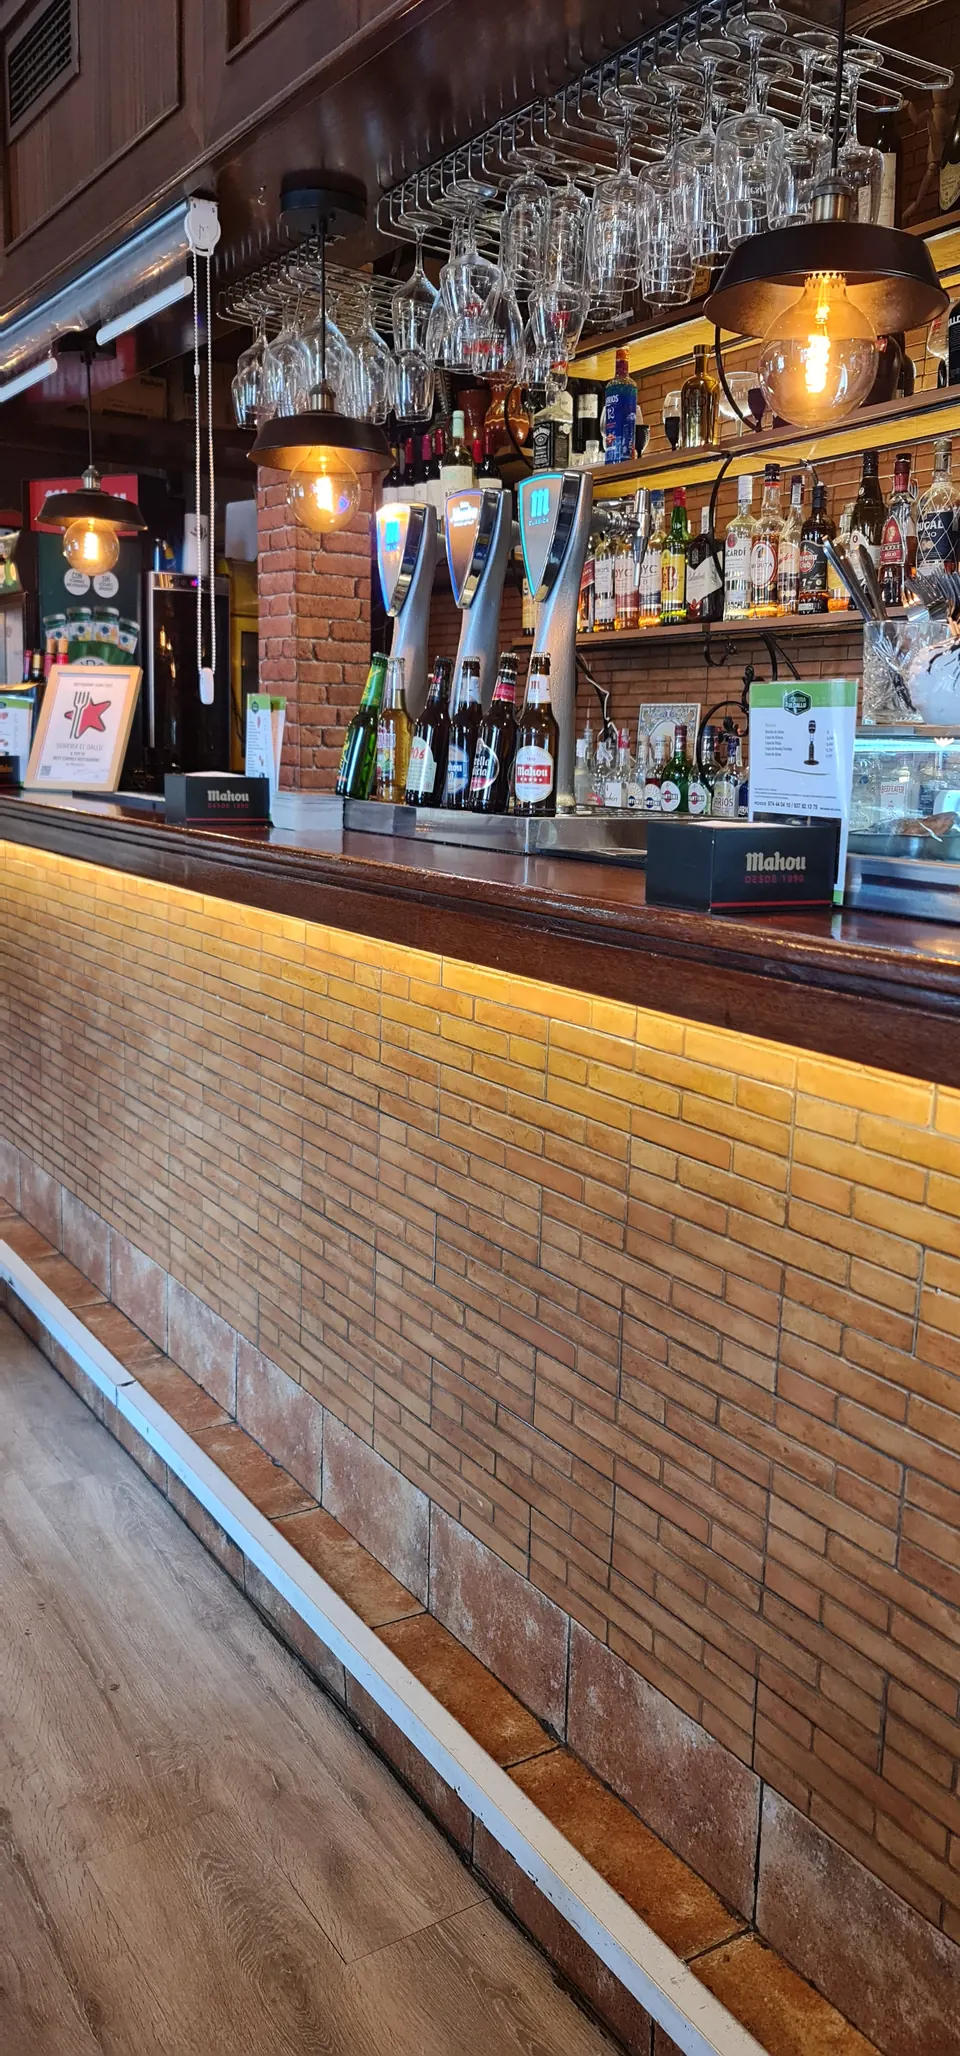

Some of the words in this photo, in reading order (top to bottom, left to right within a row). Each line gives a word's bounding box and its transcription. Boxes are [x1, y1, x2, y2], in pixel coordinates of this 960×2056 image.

[642, 564, 658, 574] YC
[517, 766, 548, 777] Mahou
[207, 790, 250, 802] Mahou
[745, 851, 806, 871] Mahou
[744, 874, 777, 884] DESDE
